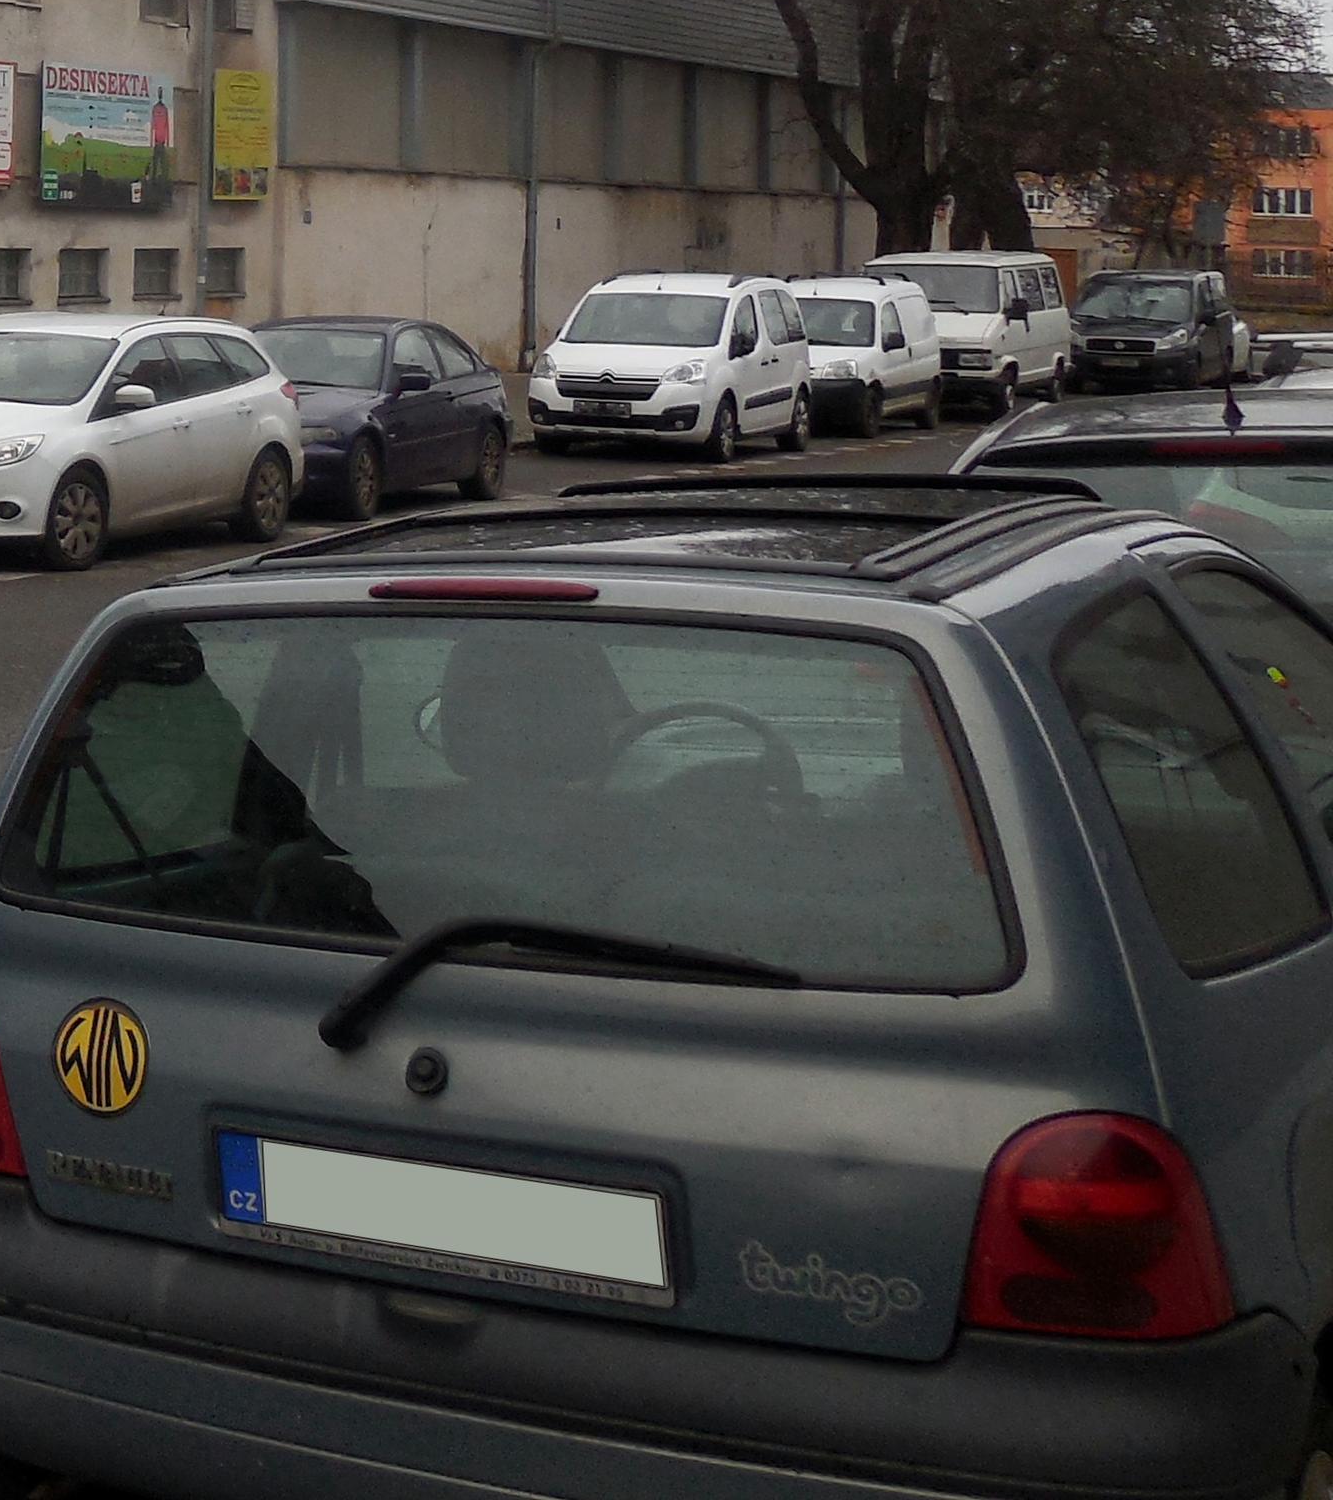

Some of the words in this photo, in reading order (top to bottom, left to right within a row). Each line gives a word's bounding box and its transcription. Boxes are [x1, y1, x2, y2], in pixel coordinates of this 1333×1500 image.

[45, 66, 150, 98] DESINSEKTA
[229, 1189, 258, 1212] CZ
[739, 1239, 924, 1327] twingo
